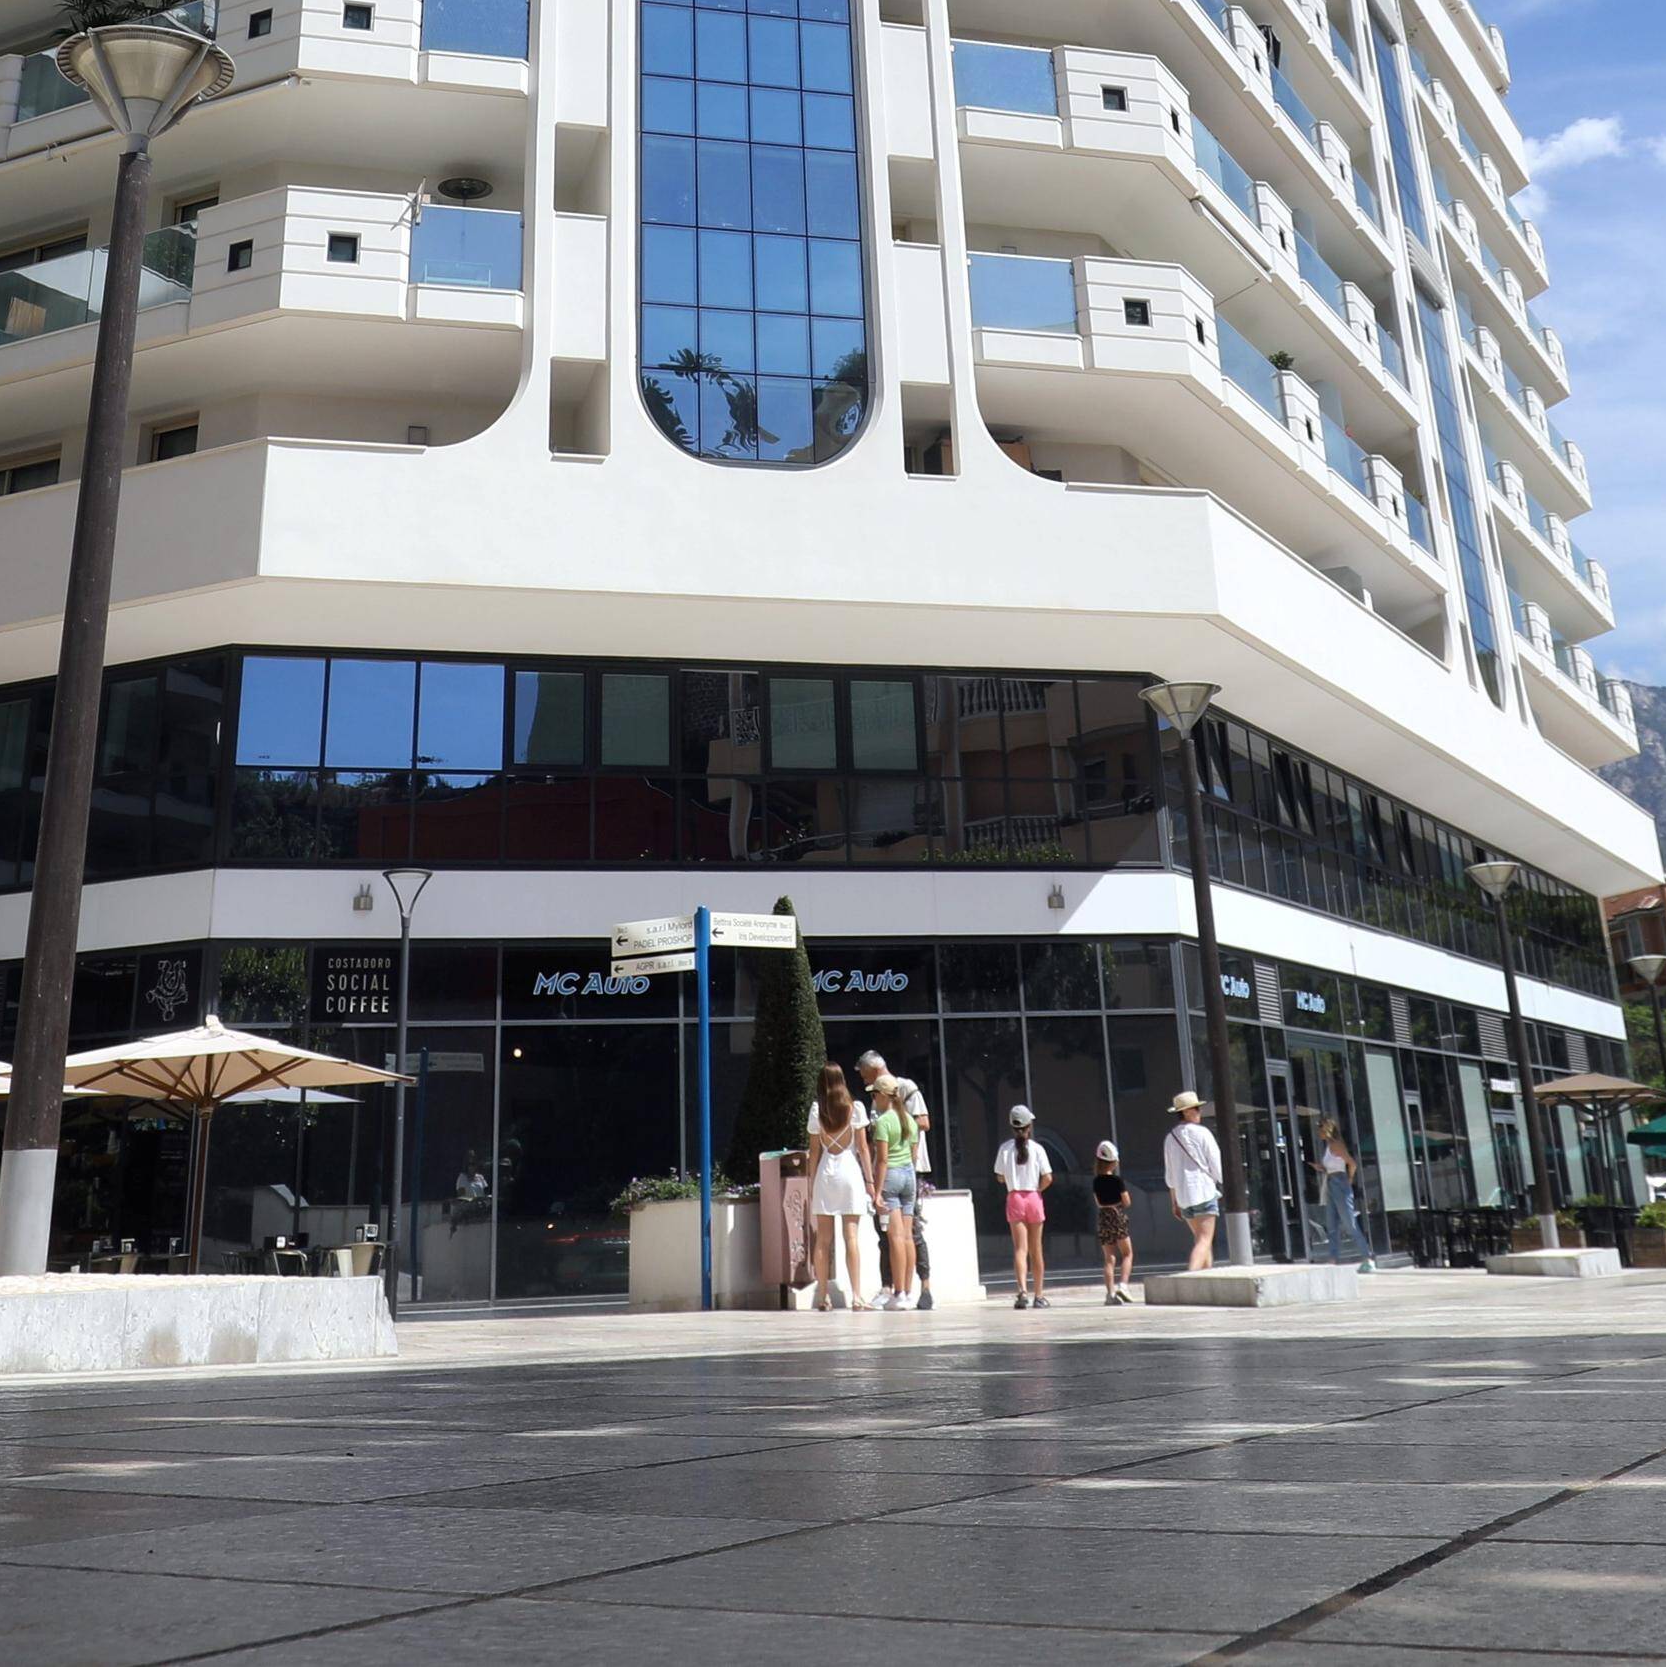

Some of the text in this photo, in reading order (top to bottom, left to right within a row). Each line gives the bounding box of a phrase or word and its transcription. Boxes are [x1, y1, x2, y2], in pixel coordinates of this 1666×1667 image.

[633, 934, 693, 949] PADEL PROSHOP
[328, 957, 391, 969] COSTADORO
[326, 974, 390, 991] SOCIAL
[533, 972, 650, 996] MC Auto
[844, 969, 908, 993] Auto
[326, 996, 389, 1013] COFFEE
